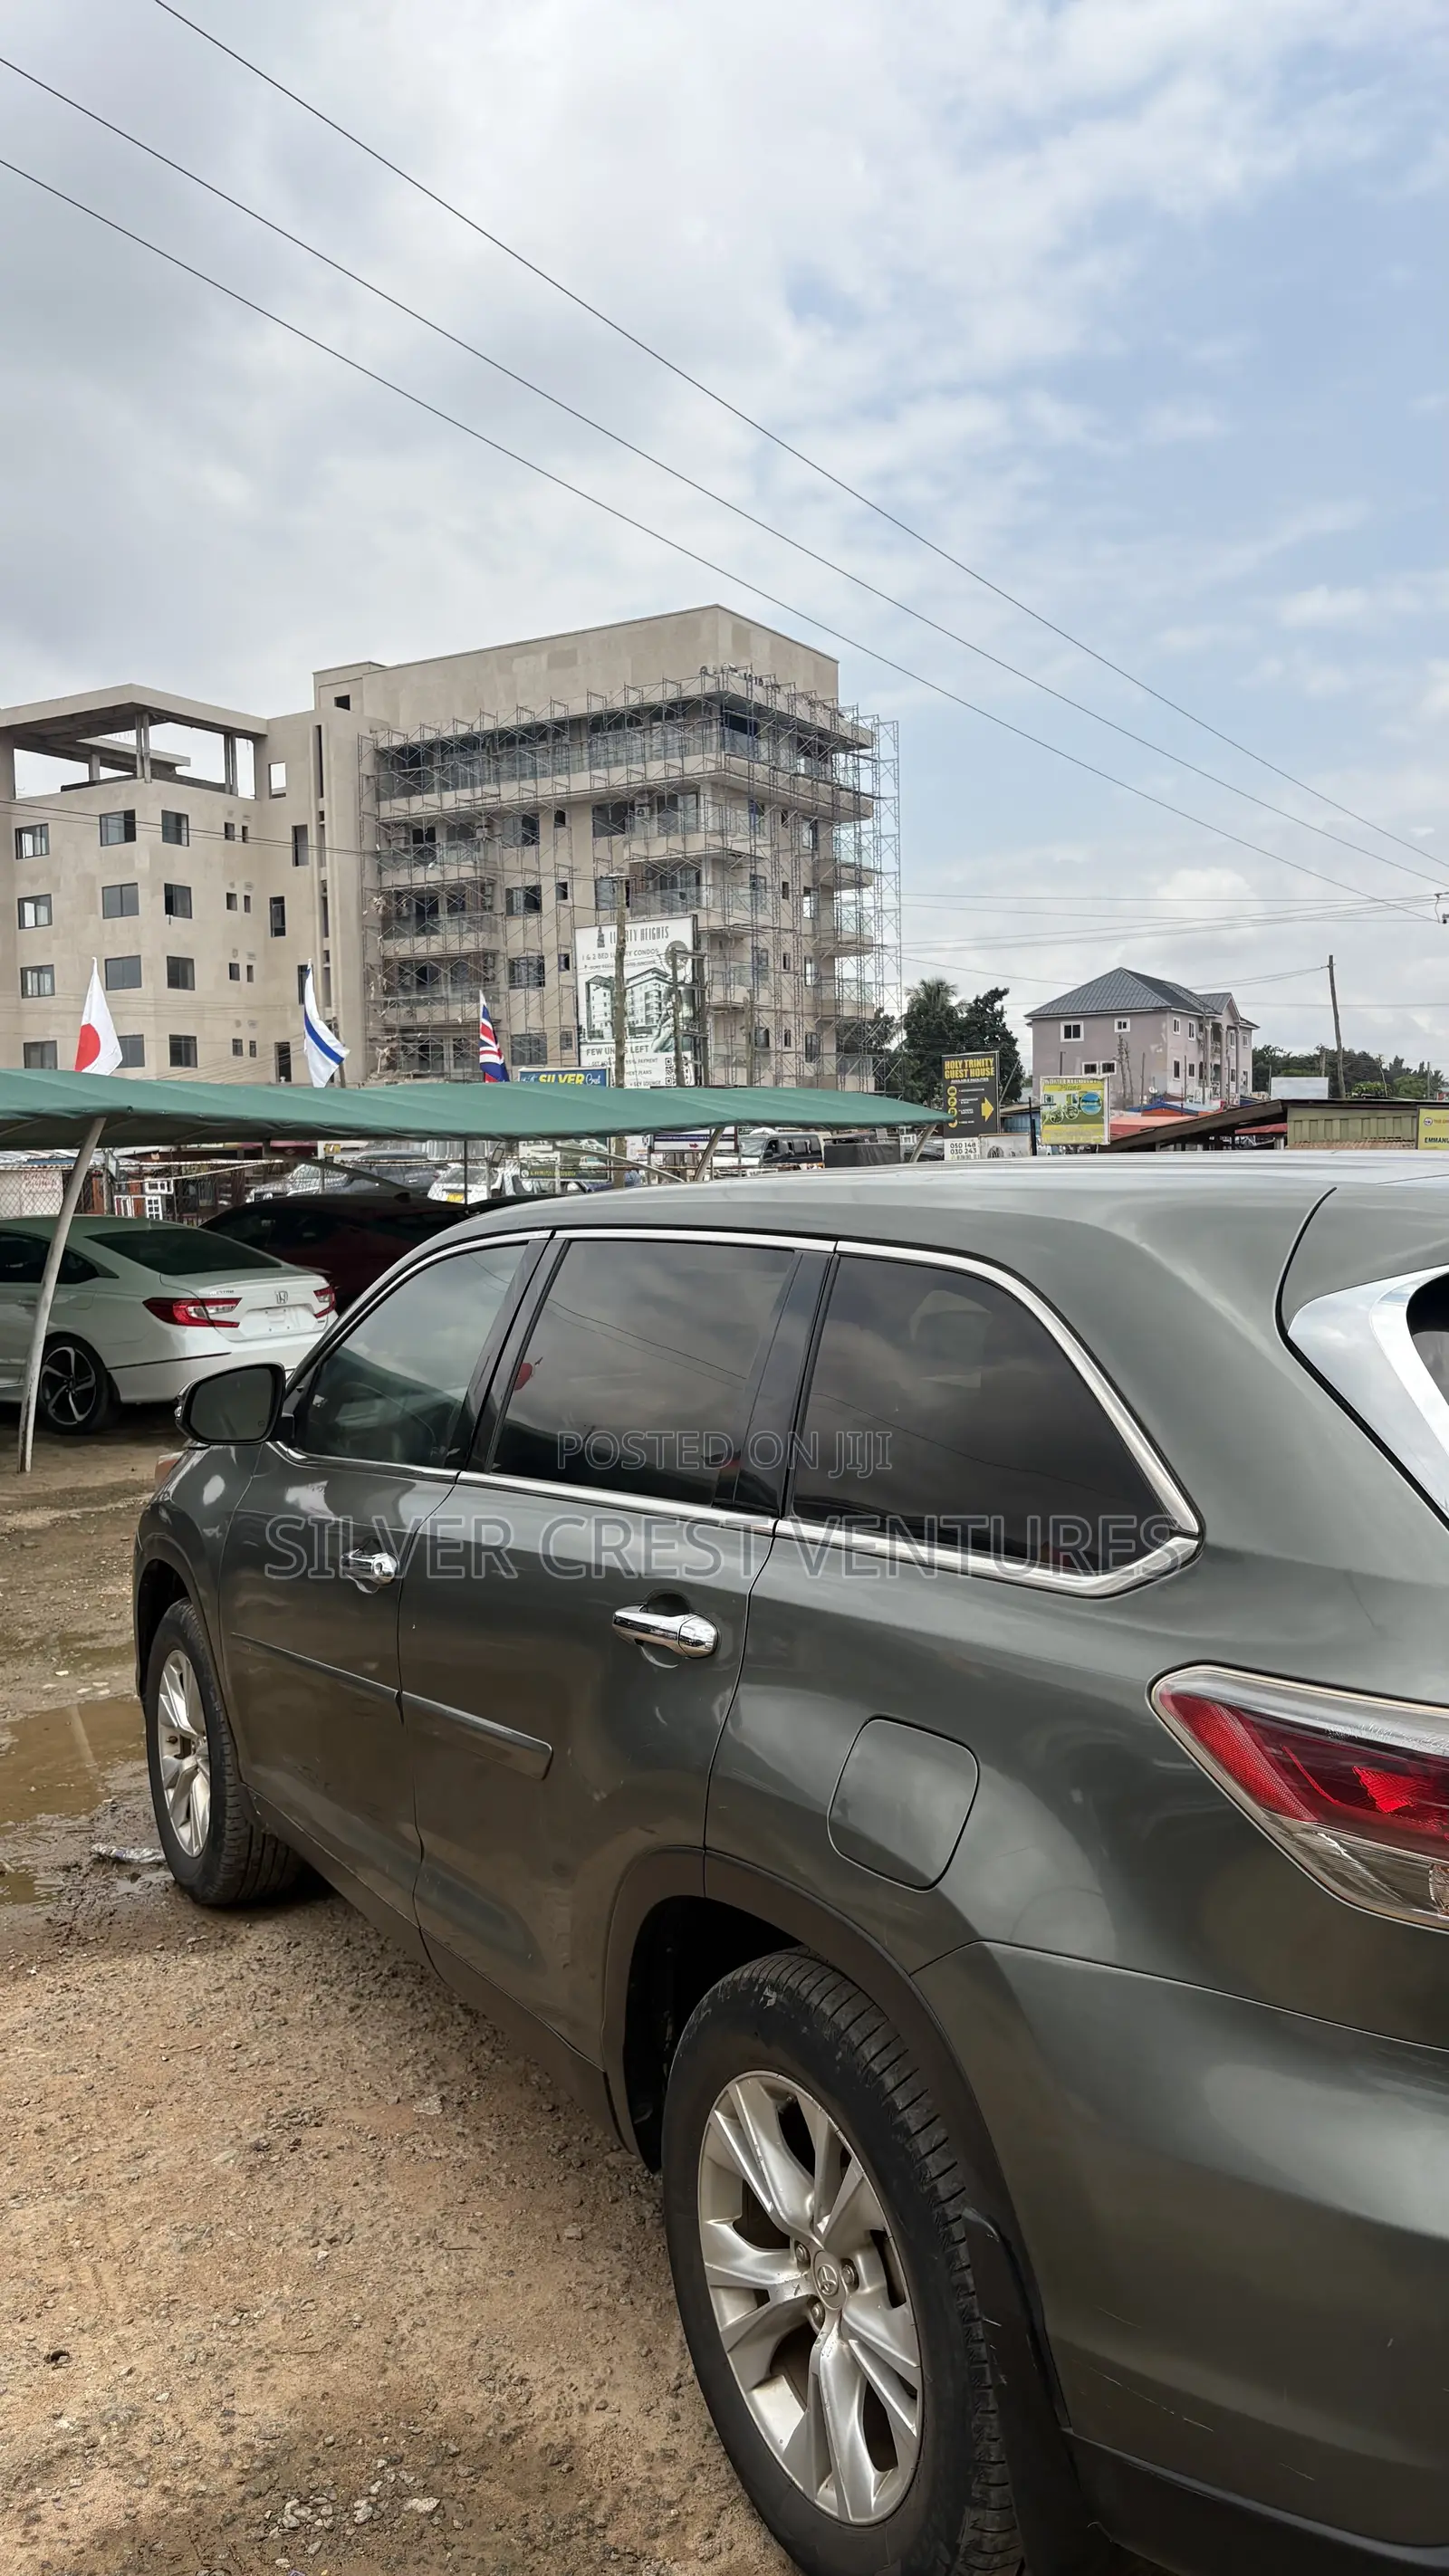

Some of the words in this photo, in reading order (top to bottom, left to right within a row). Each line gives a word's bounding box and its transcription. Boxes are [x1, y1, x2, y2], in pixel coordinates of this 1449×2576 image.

[609, 929, 638, 943] LIRTY
[640, 925, 669, 942] HEIGHTS
[609, 950, 632, 959] LURY
[634, 948, 659, 956] CONDOS
[586, 1047, 603, 1056] FEW
[605, 1046, 629, 1055] UNS
[630, 1045, 649, 1053] LEFT
[945, 1059, 963, 1069] HOLY
[964, 1058, 994, 1068] TRINITY
[945, 1068, 968, 1079] GUEST
[969, 1067, 995, 1077] HOUSE
